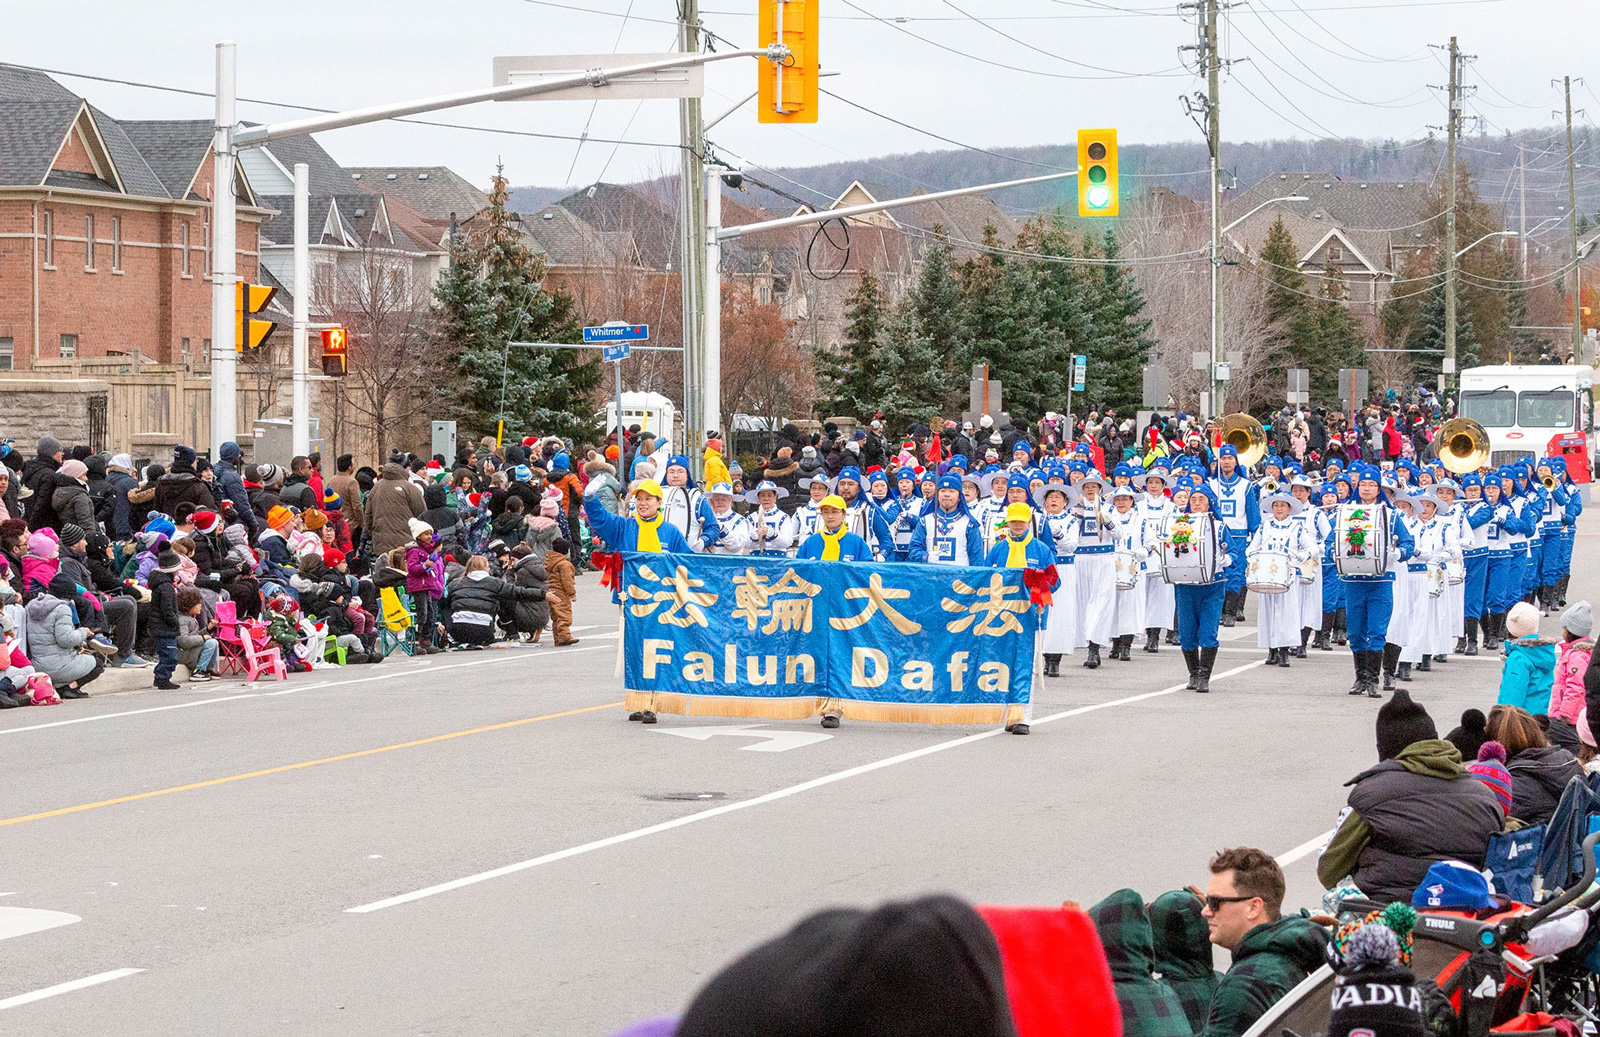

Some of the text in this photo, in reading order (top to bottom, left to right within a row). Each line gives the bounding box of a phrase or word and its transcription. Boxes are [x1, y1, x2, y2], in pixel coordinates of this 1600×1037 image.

[591, 328, 624, 336] Whitmer
[627, 564, 1031, 637] 法輪大法
[642, 638, 1010, 693] Falun Dafa
[1425, 918, 1455, 930] THULE
